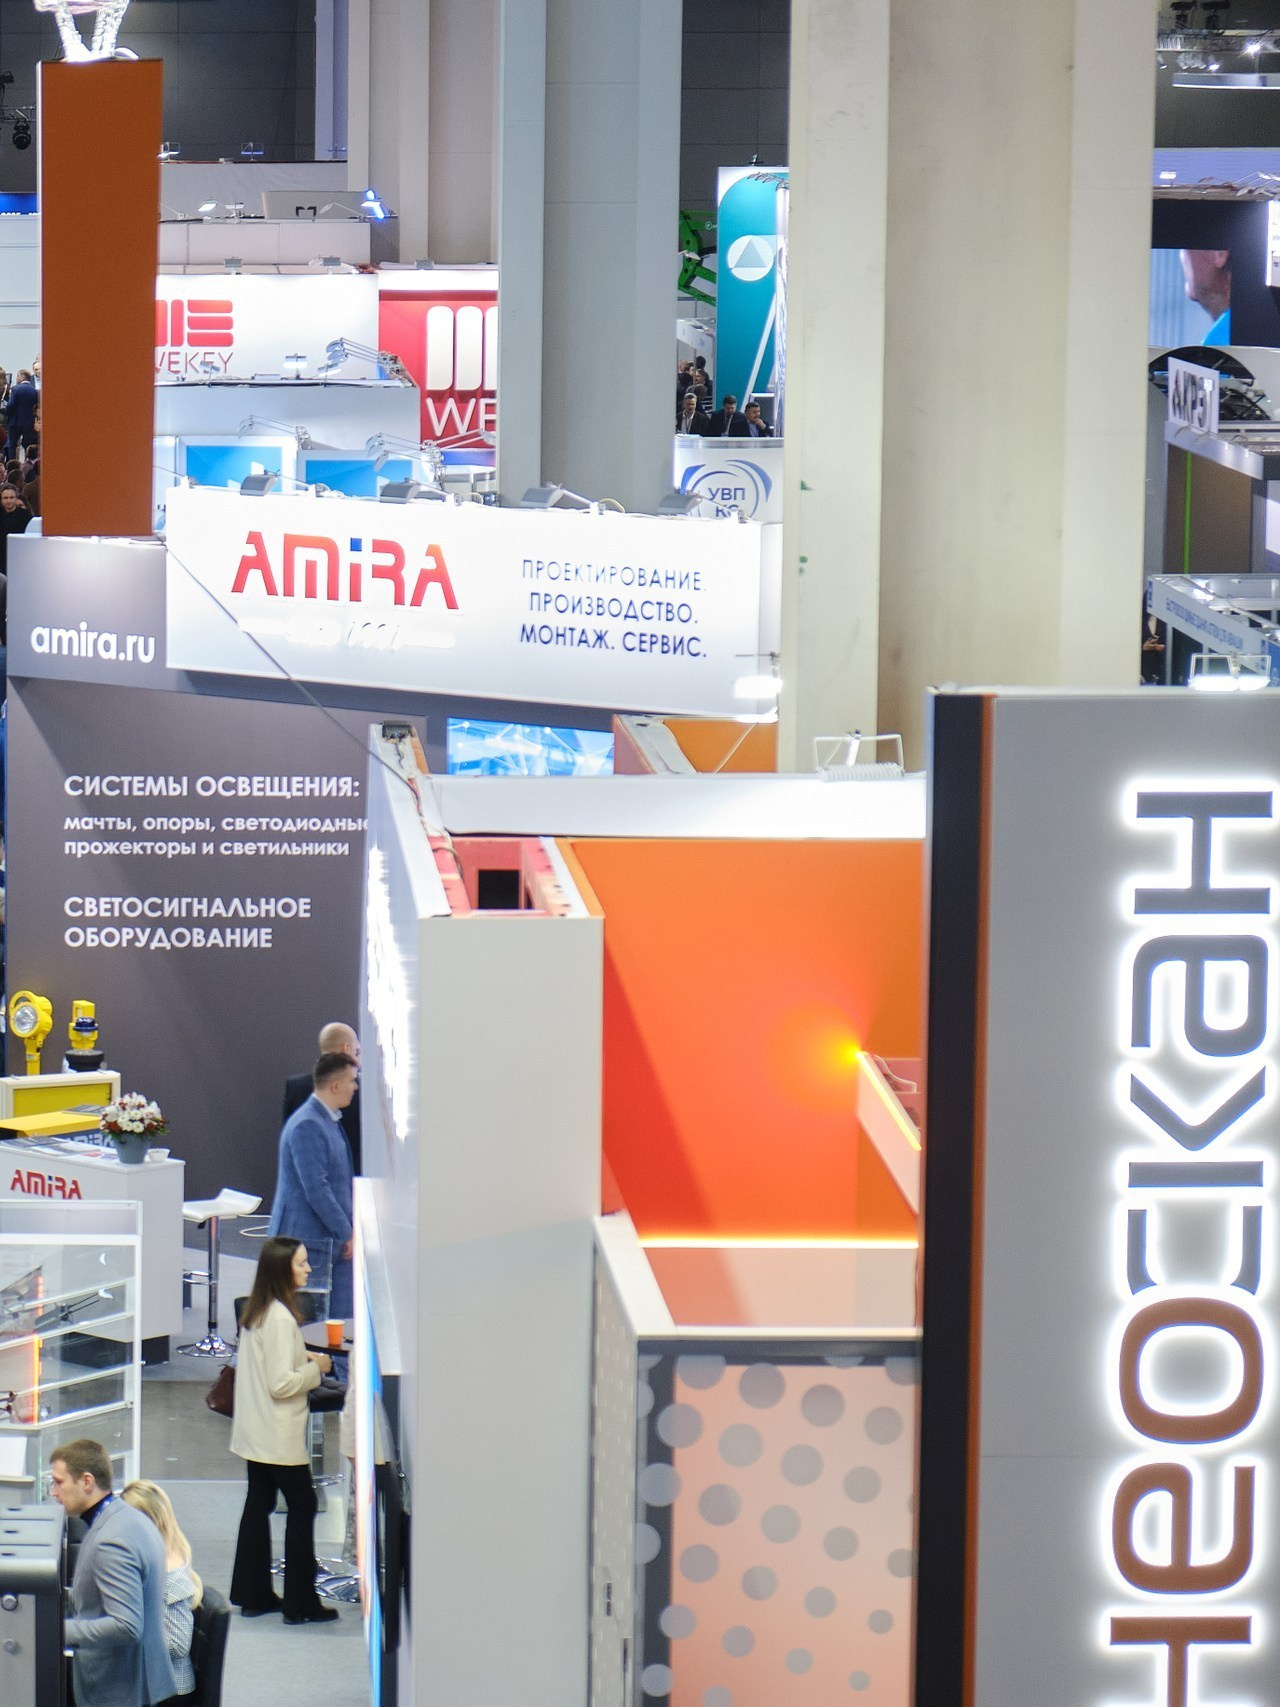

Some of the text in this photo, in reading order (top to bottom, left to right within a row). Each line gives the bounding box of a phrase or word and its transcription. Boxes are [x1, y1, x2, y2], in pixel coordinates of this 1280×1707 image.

[708, 487, 746, 501] УВП
[522, 559, 707, 592] ПРОЕКТИРОВАНИЕ.
[529, 592, 698, 623] ПРОИЗВОДСТВО.
[31, 621, 156, 663] amira.ru
[520, 623, 707, 658] МОНТАЖ. СЕРВИС.
[64, 775, 360, 799] СИСТЕМЫ ОСВЕЩЕНИЯ:
[64, 816, 137, 833] мачты,
[143, 816, 216, 834] опоры,
[64, 839, 350, 858] прожекторы и светильники
[64, 896, 312, 918] СВЕТОСИГНАЛЬНОЕ
[64, 926, 273, 950] ОБОРУДОВАНИЕ
